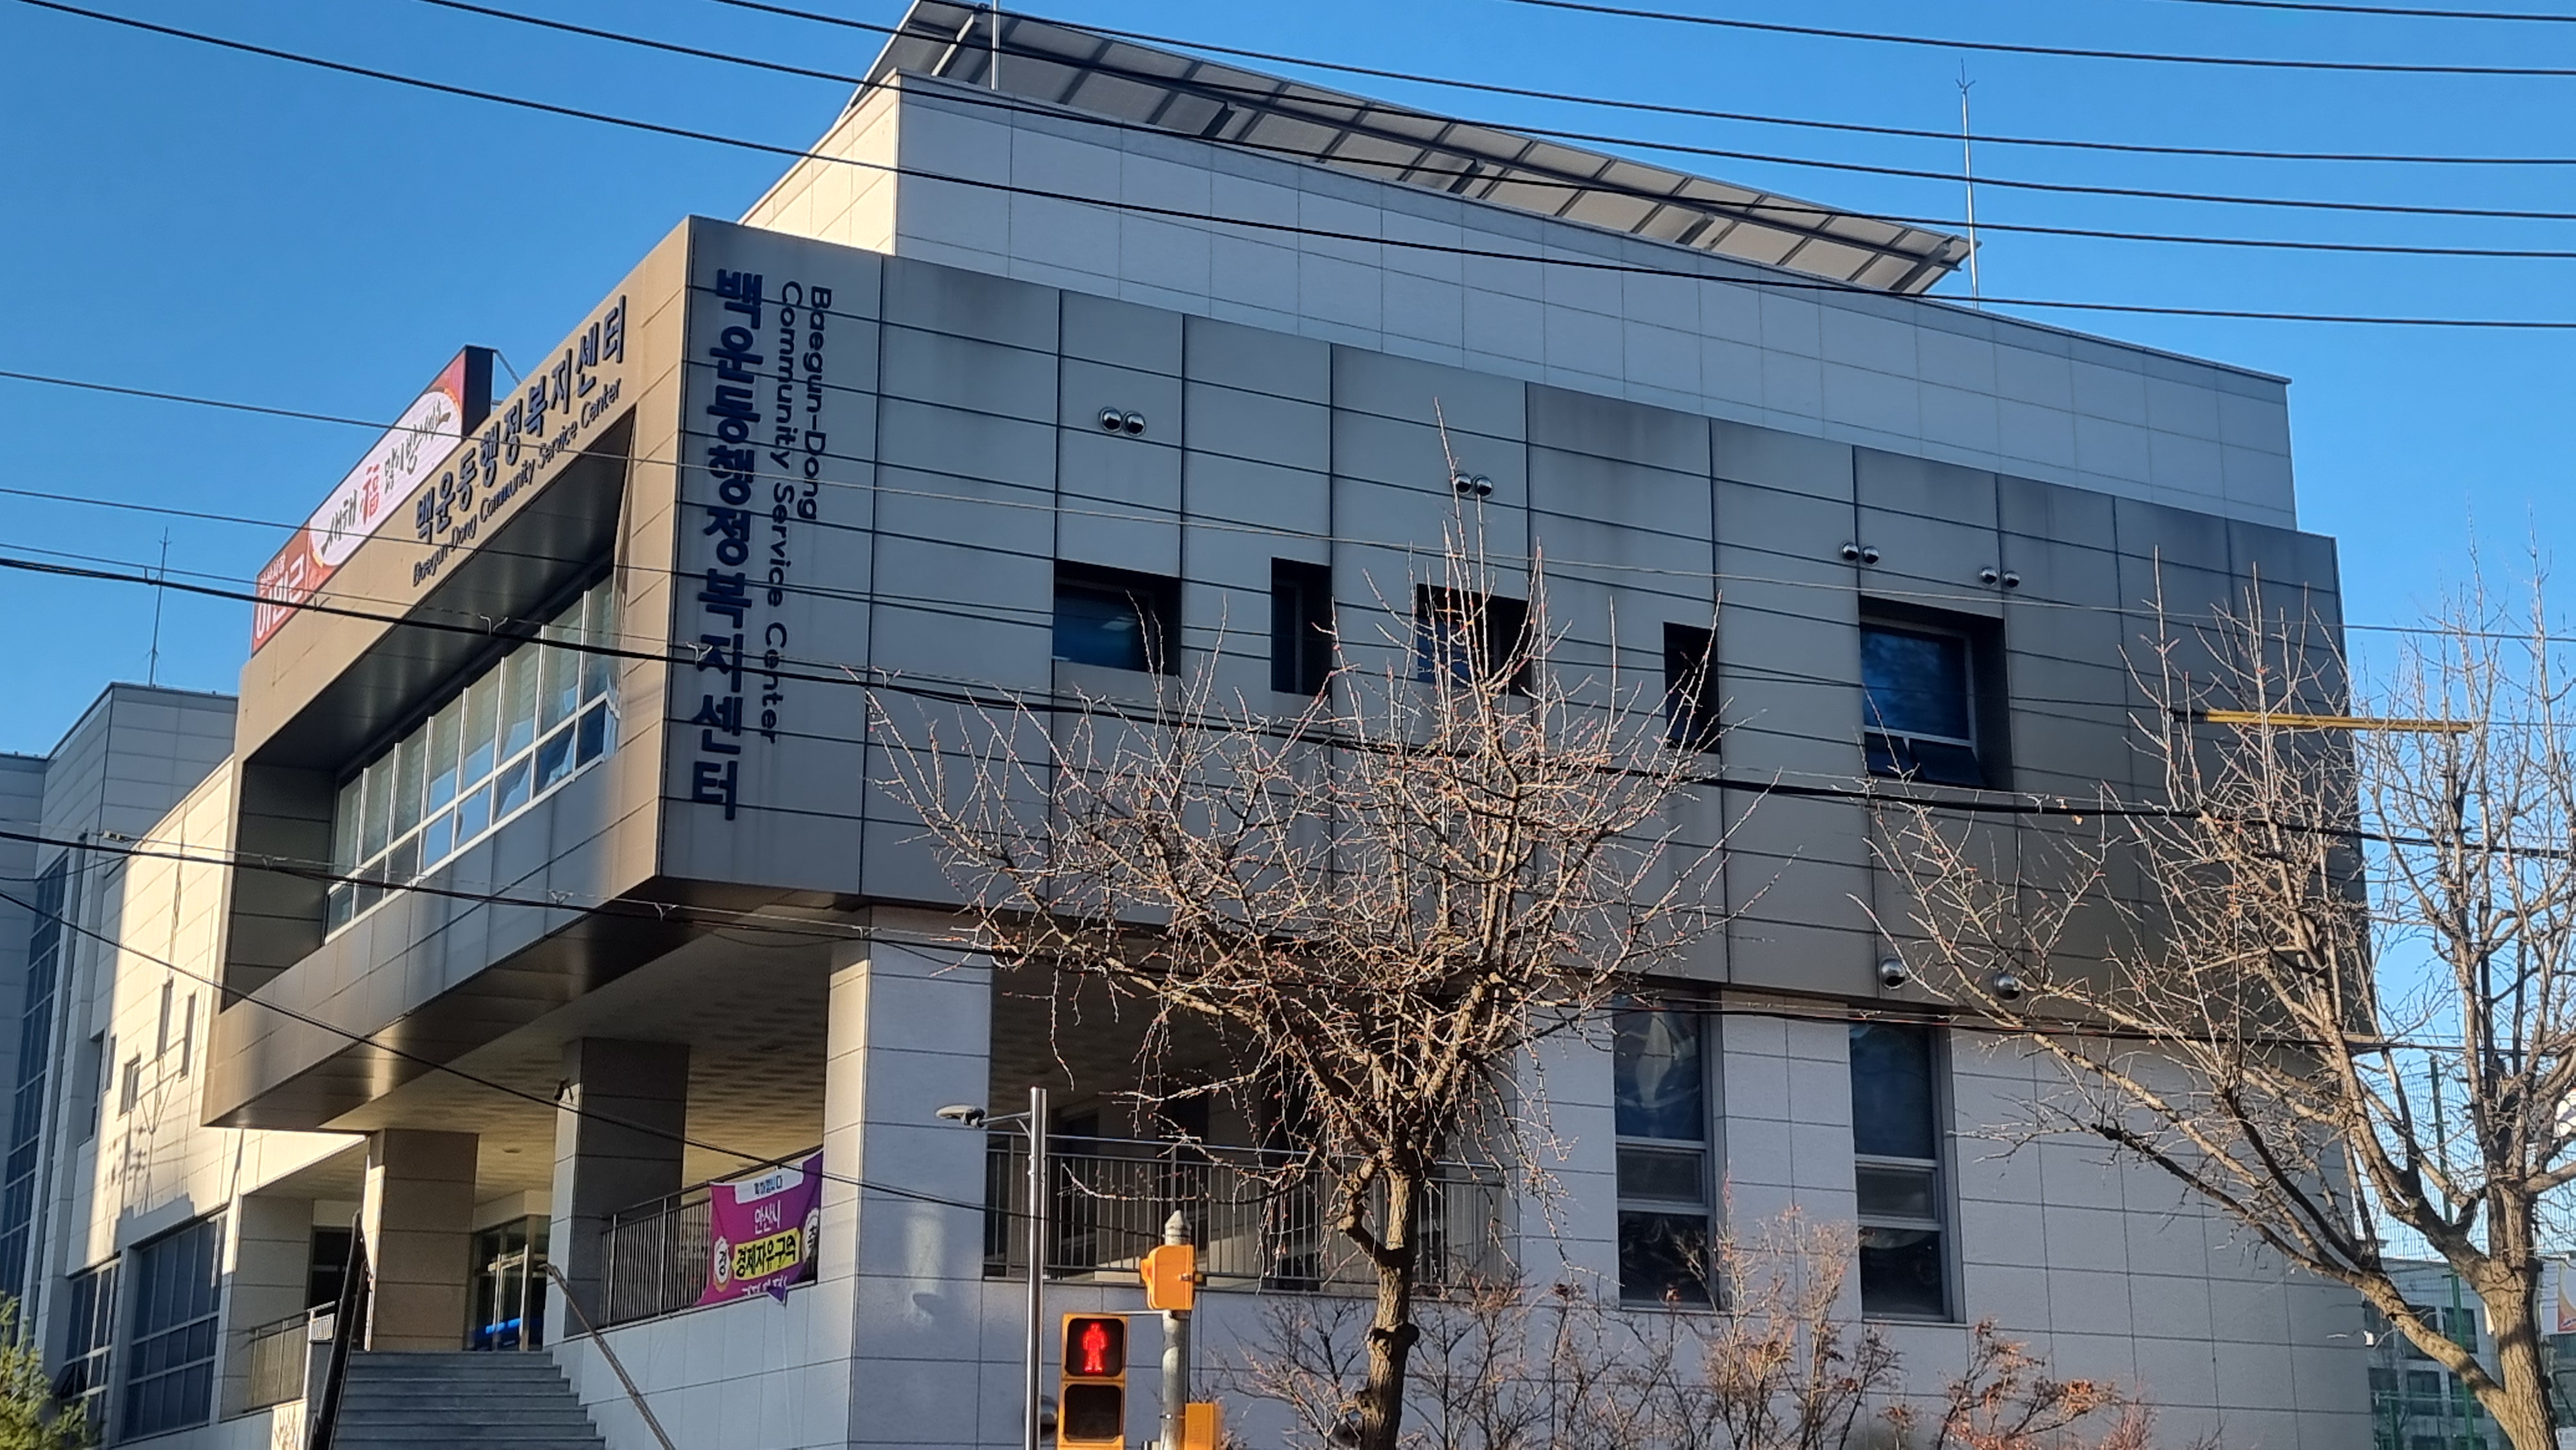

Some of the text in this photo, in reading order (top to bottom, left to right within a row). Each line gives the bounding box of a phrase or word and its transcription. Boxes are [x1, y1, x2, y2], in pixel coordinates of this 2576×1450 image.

[415, 294, 627, 545] 백운동행정복지센터
[480, 458, 535, 523] Community
[539, 421, 578, 469] Service
[581, 377, 621, 429] Center
[796, 285, 832, 520] Baegun-Dong
[321, 488, 358, 558] 새해
[691, 268, 764, 821] 백운동행정복지센터
[760, 280, 803, 744] Community Service Center
[736, 1234, 797, 1278] 경제자유구역
[754, 1199, 781, 1235] 안산시
